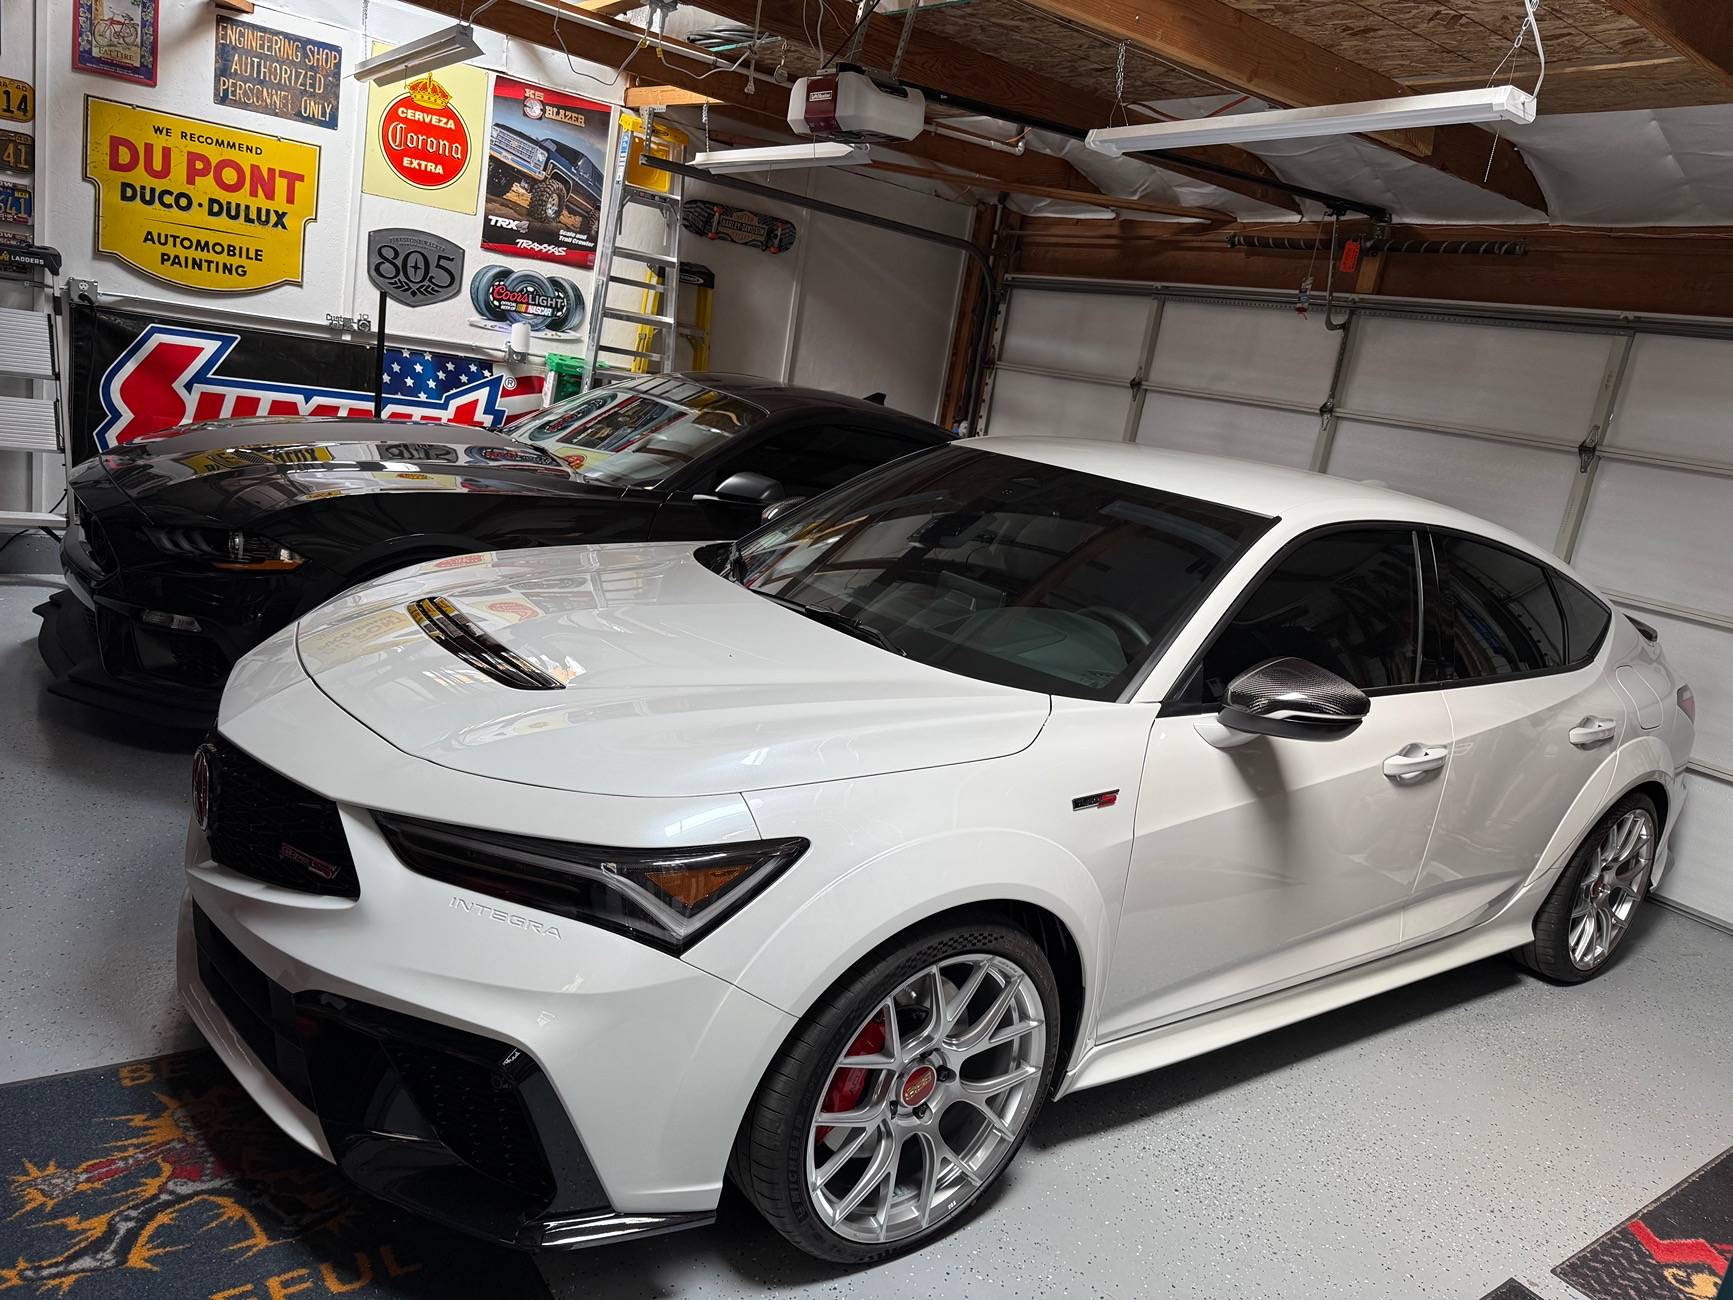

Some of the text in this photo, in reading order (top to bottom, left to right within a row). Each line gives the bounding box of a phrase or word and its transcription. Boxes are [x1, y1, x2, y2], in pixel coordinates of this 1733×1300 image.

[114, 49, 134, 61] TIRE
[219, 23, 339, 70] ENGINEERING SHOP
[231, 53, 324, 93] AUTHORIZED
[301, 96, 332, 121] ONLY
[397, 107, 456, 130] CERVEZA
[544, 105, 585, 128] BLAZER
[152, 125, 263, 156] WE RECOMMEND
[387, 121, 462, 160] Corona
[108, 135, 305, 205] DU PONT
[402, 156, 444, 175] EXTRA
[142, 230, 264, 262] AUTOMOBILE
[515, 238, 568, 256] TRAXXAS
[11, 255, 45, 265] LADDERS
[160, 252, 248, 278] PAINTING
[374, 244, 456, 289] 805
[493, 285, 563, 309] Coors LIGHT
[527, 304, 553, 317] NASCAR
[448, 896, 562, 941] INTEGRA
